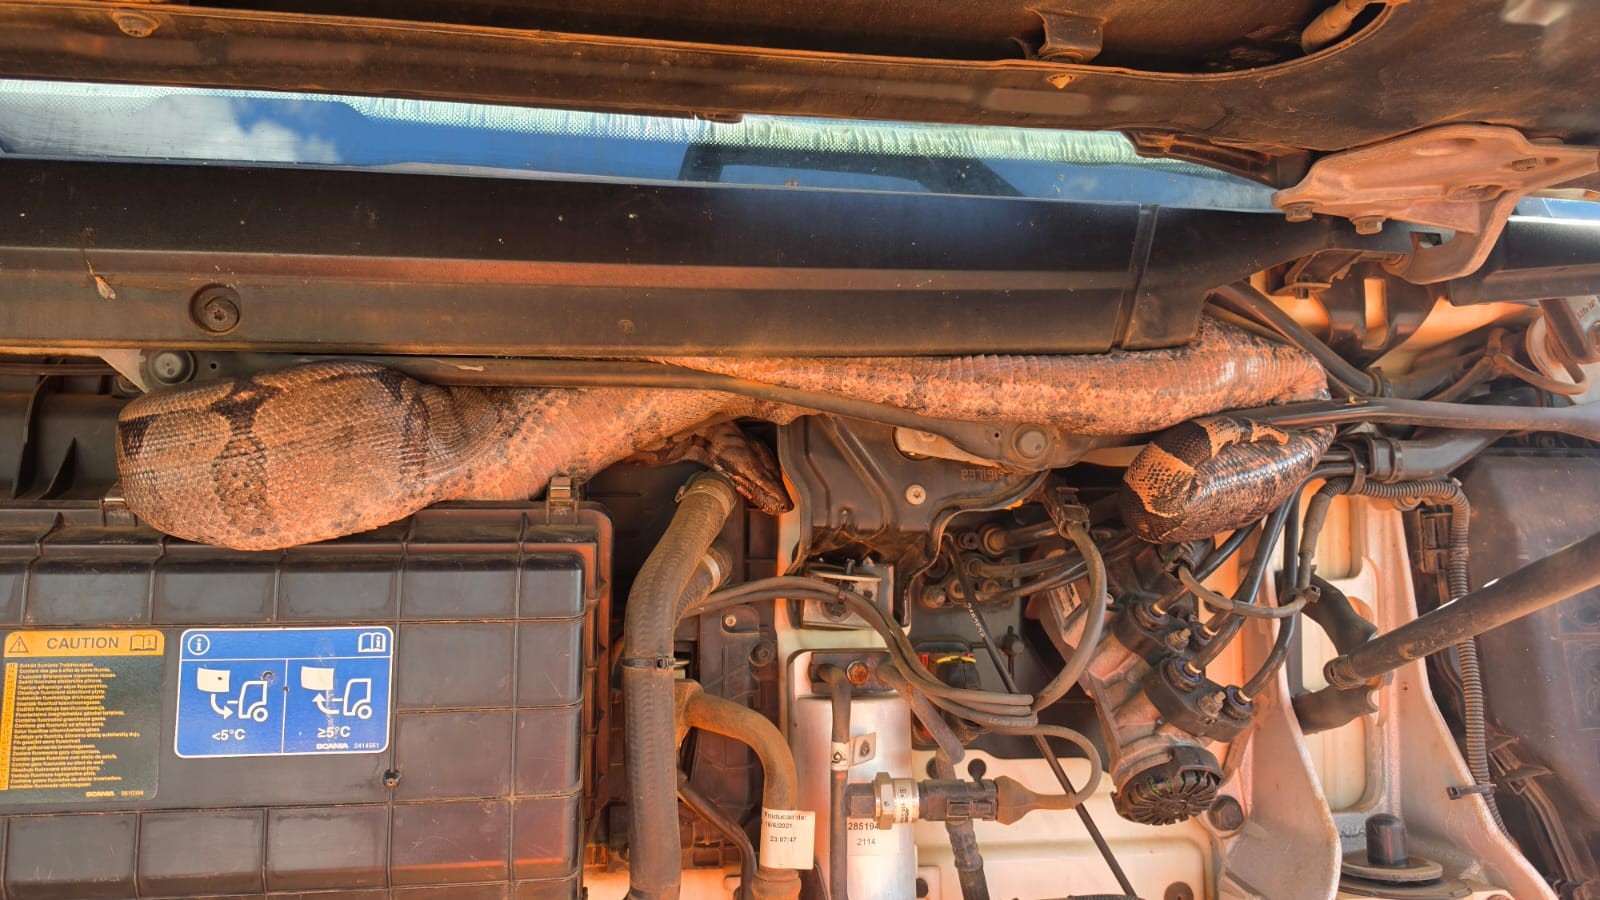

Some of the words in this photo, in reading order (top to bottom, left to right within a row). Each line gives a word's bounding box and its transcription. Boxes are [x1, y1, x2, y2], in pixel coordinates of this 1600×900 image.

[46, 637, 119, 650] CAUTION
[211, 728, 246, 741] <5°C
[317, 725, 351, 739] ≥5°C
[315, 742, 349, 750] SCANIA
[856, 838, 876, 846] 2114
